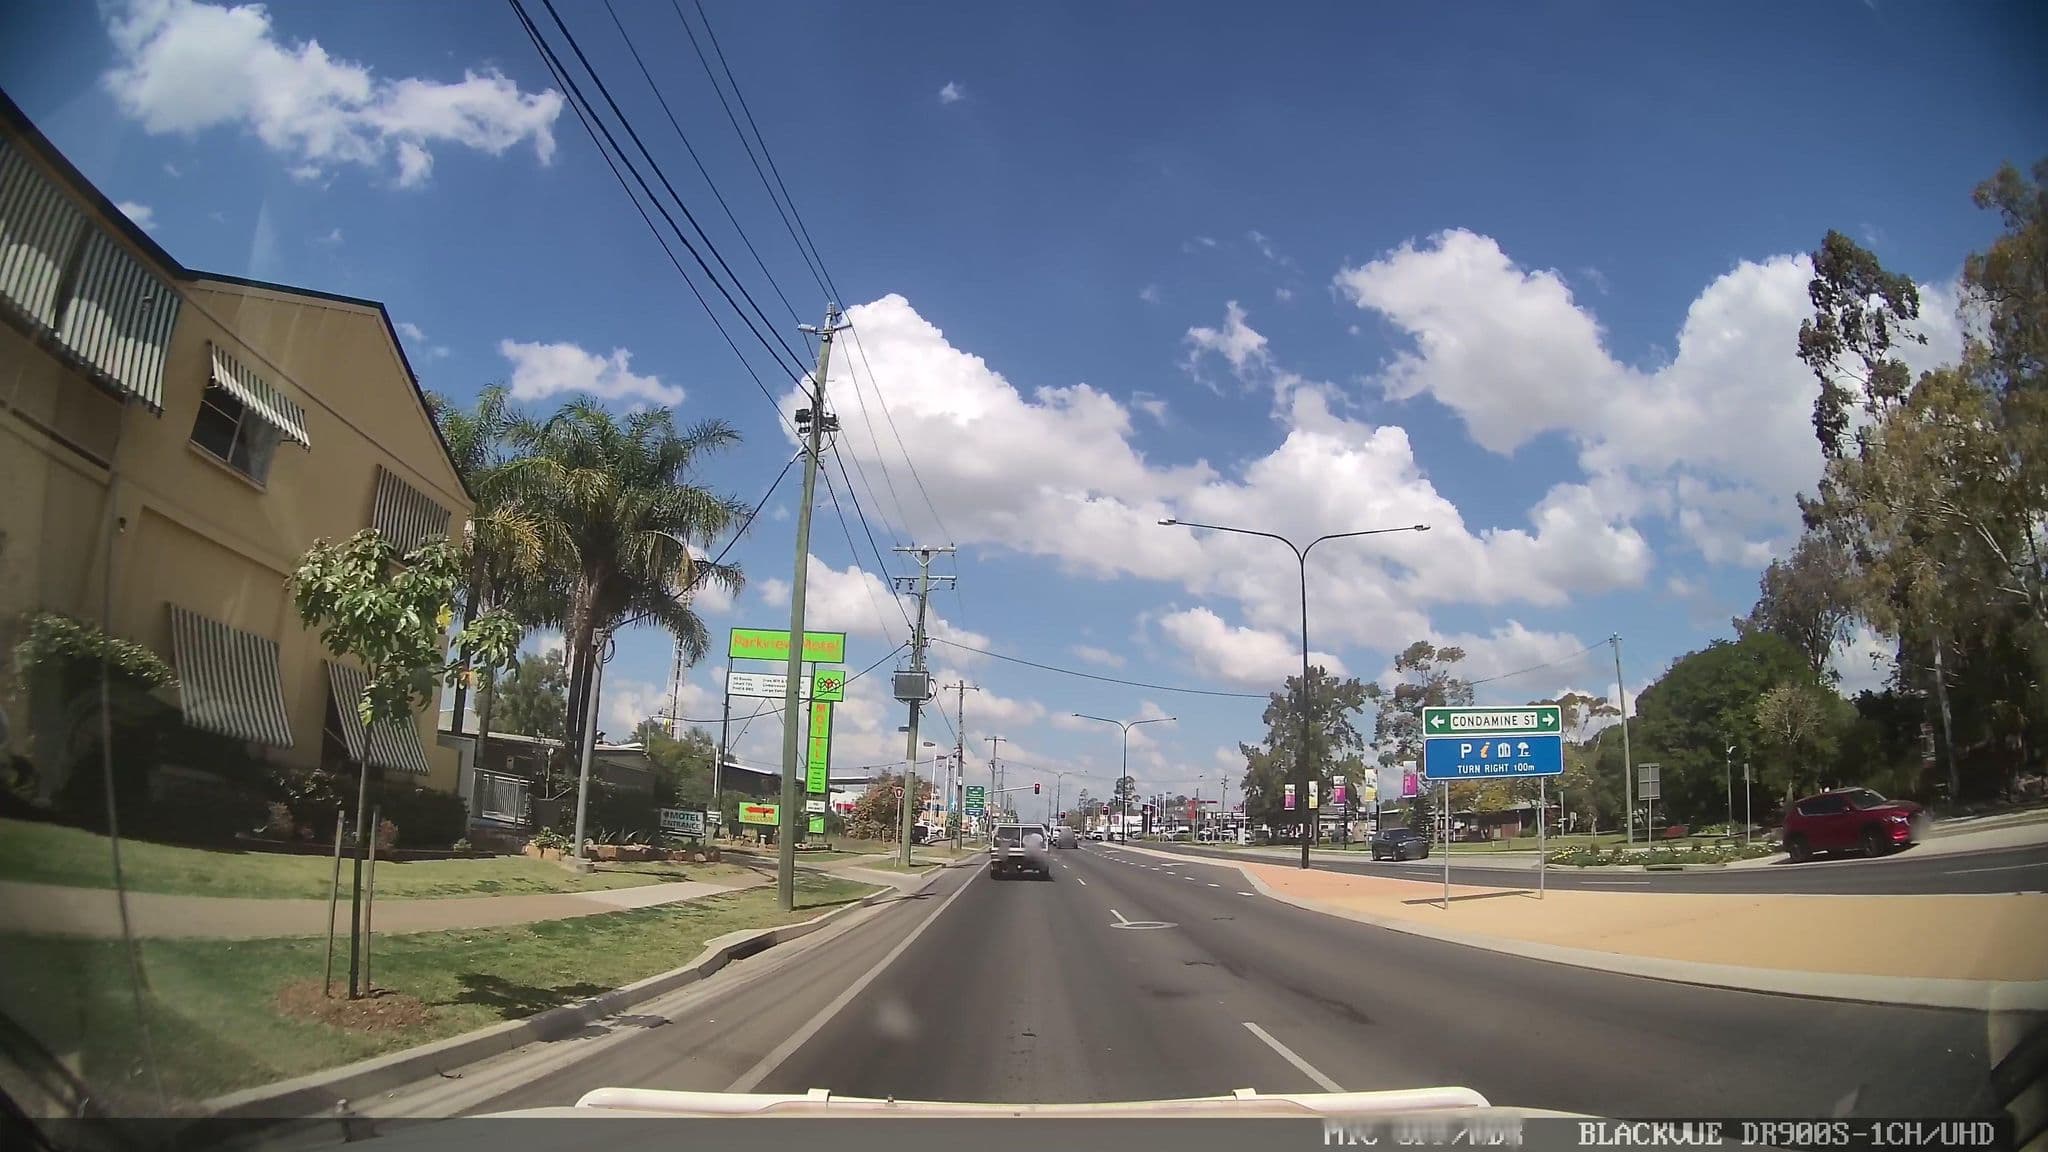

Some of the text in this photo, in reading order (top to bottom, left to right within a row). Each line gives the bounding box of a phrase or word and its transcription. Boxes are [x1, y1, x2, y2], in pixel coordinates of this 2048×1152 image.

[1452, 714, 1536, 727] CONDAMINE ST
[815, 703, 826, 761] MOTEL
[1460, 743, 1472, 759] P
[1457, 763, 1535, 774] TURN RIGHT 100m
[669, 811, 701, 822] MOTEL
[663, 819, 701, 831] ENTRANCE
